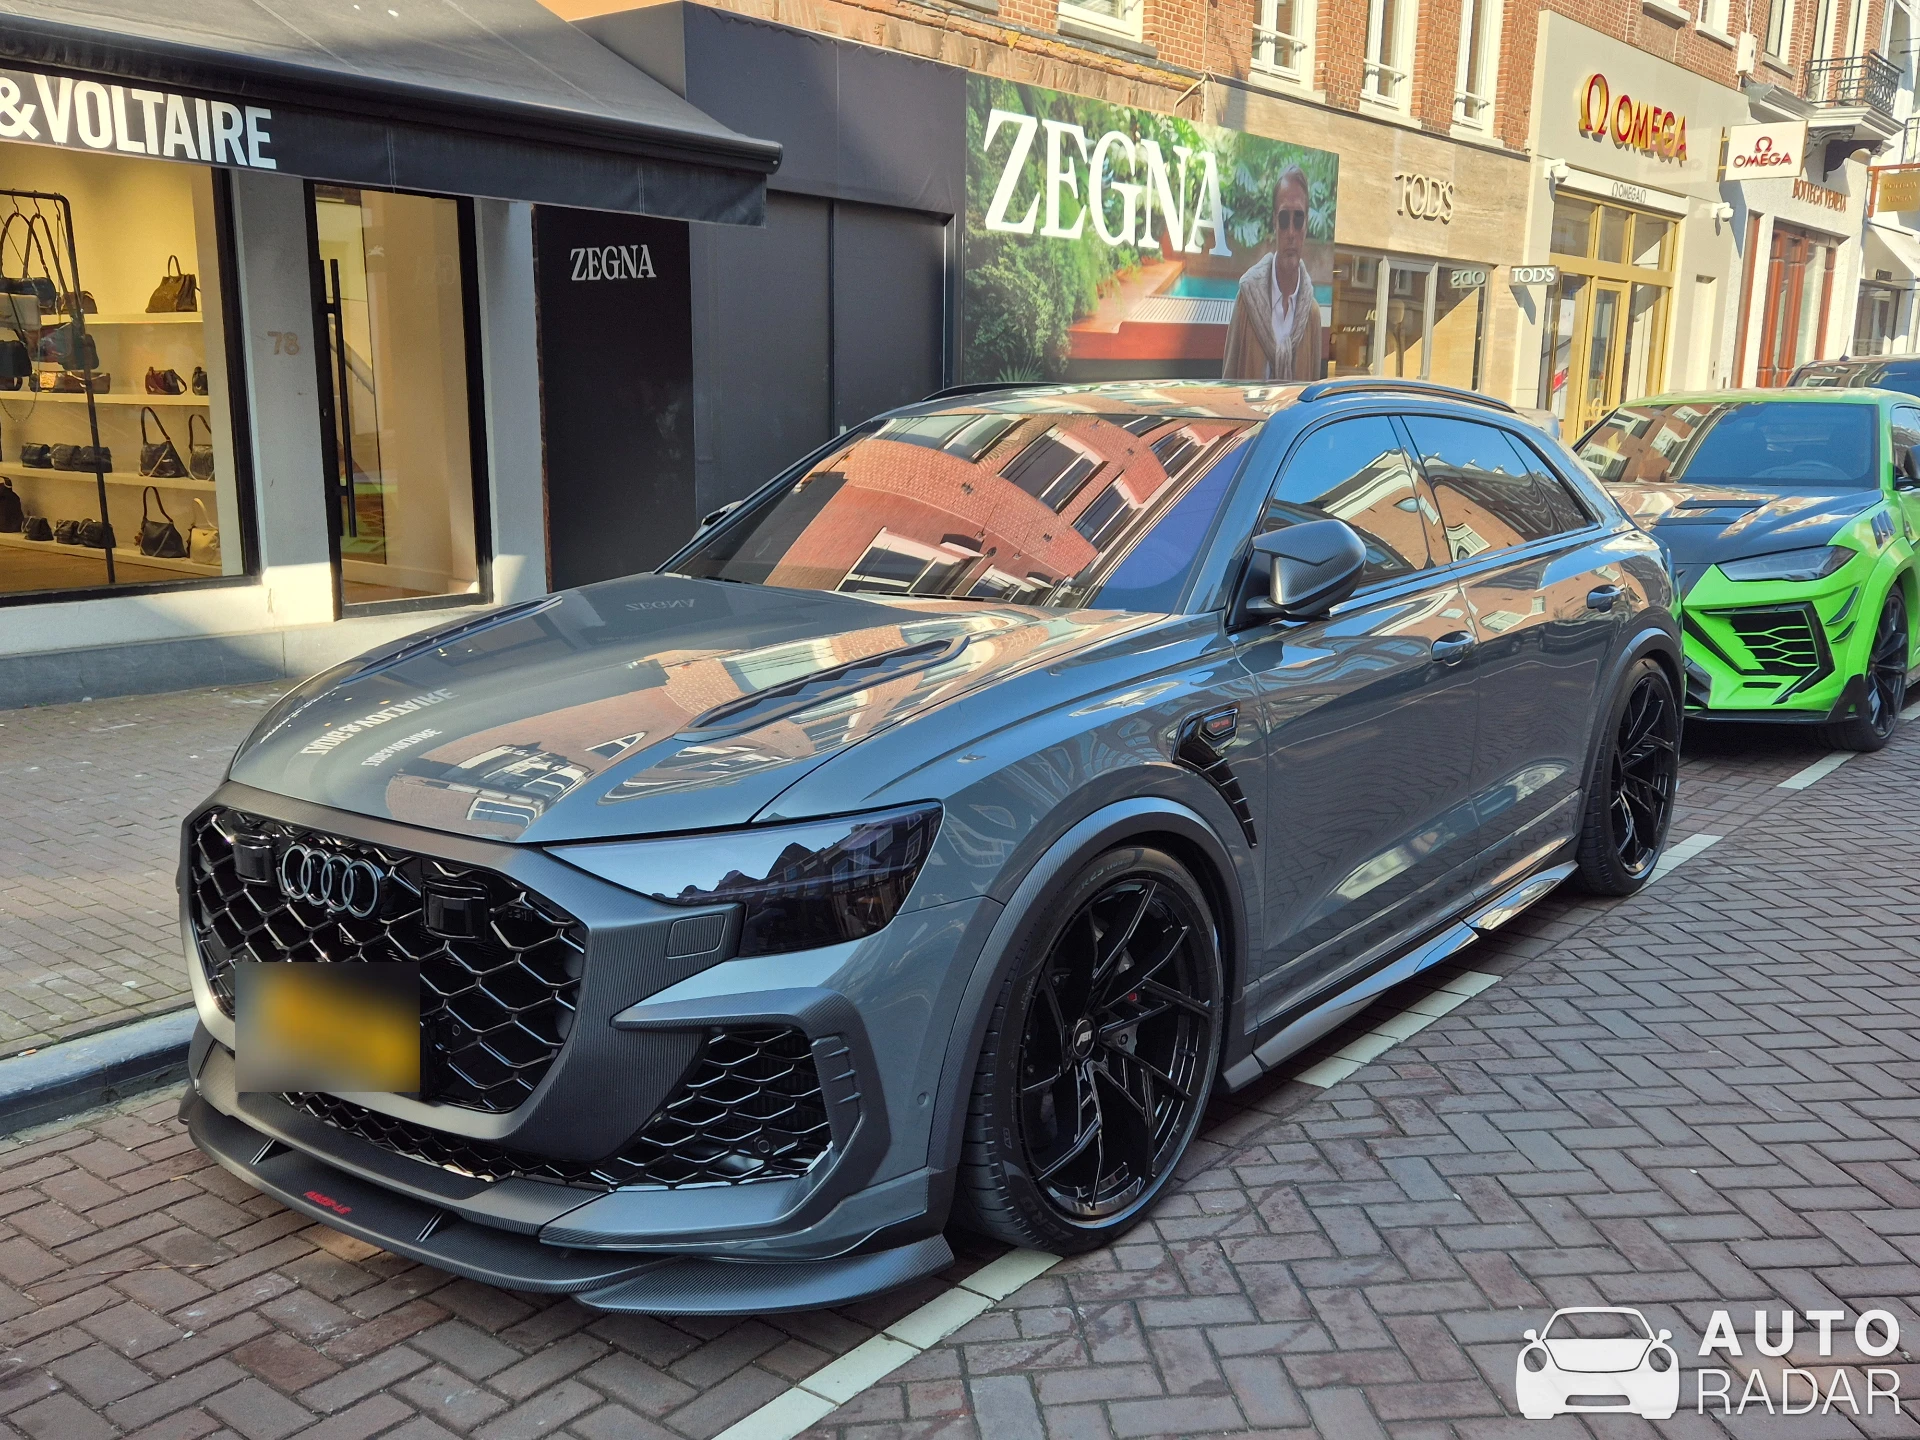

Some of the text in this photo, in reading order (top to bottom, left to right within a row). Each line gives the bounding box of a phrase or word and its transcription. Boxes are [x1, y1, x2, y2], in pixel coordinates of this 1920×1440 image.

[1610, 94, 1688, 161] OMEGA
[1733, 151, 1793, 168] OMEGA
[983, 108, 1233, 257] ZEGNA
[1395, 171, 1455, 223] TOD'S
[1619, 184, 1640, 202] OMEGA
[1792, 178, 1847, 213] BOTTEGA VENETA
[570, 244, 656, 282] ZEGNA
[1512, 267, 1556, 283] TOD'S
[267, 330, 300, 356] 78
